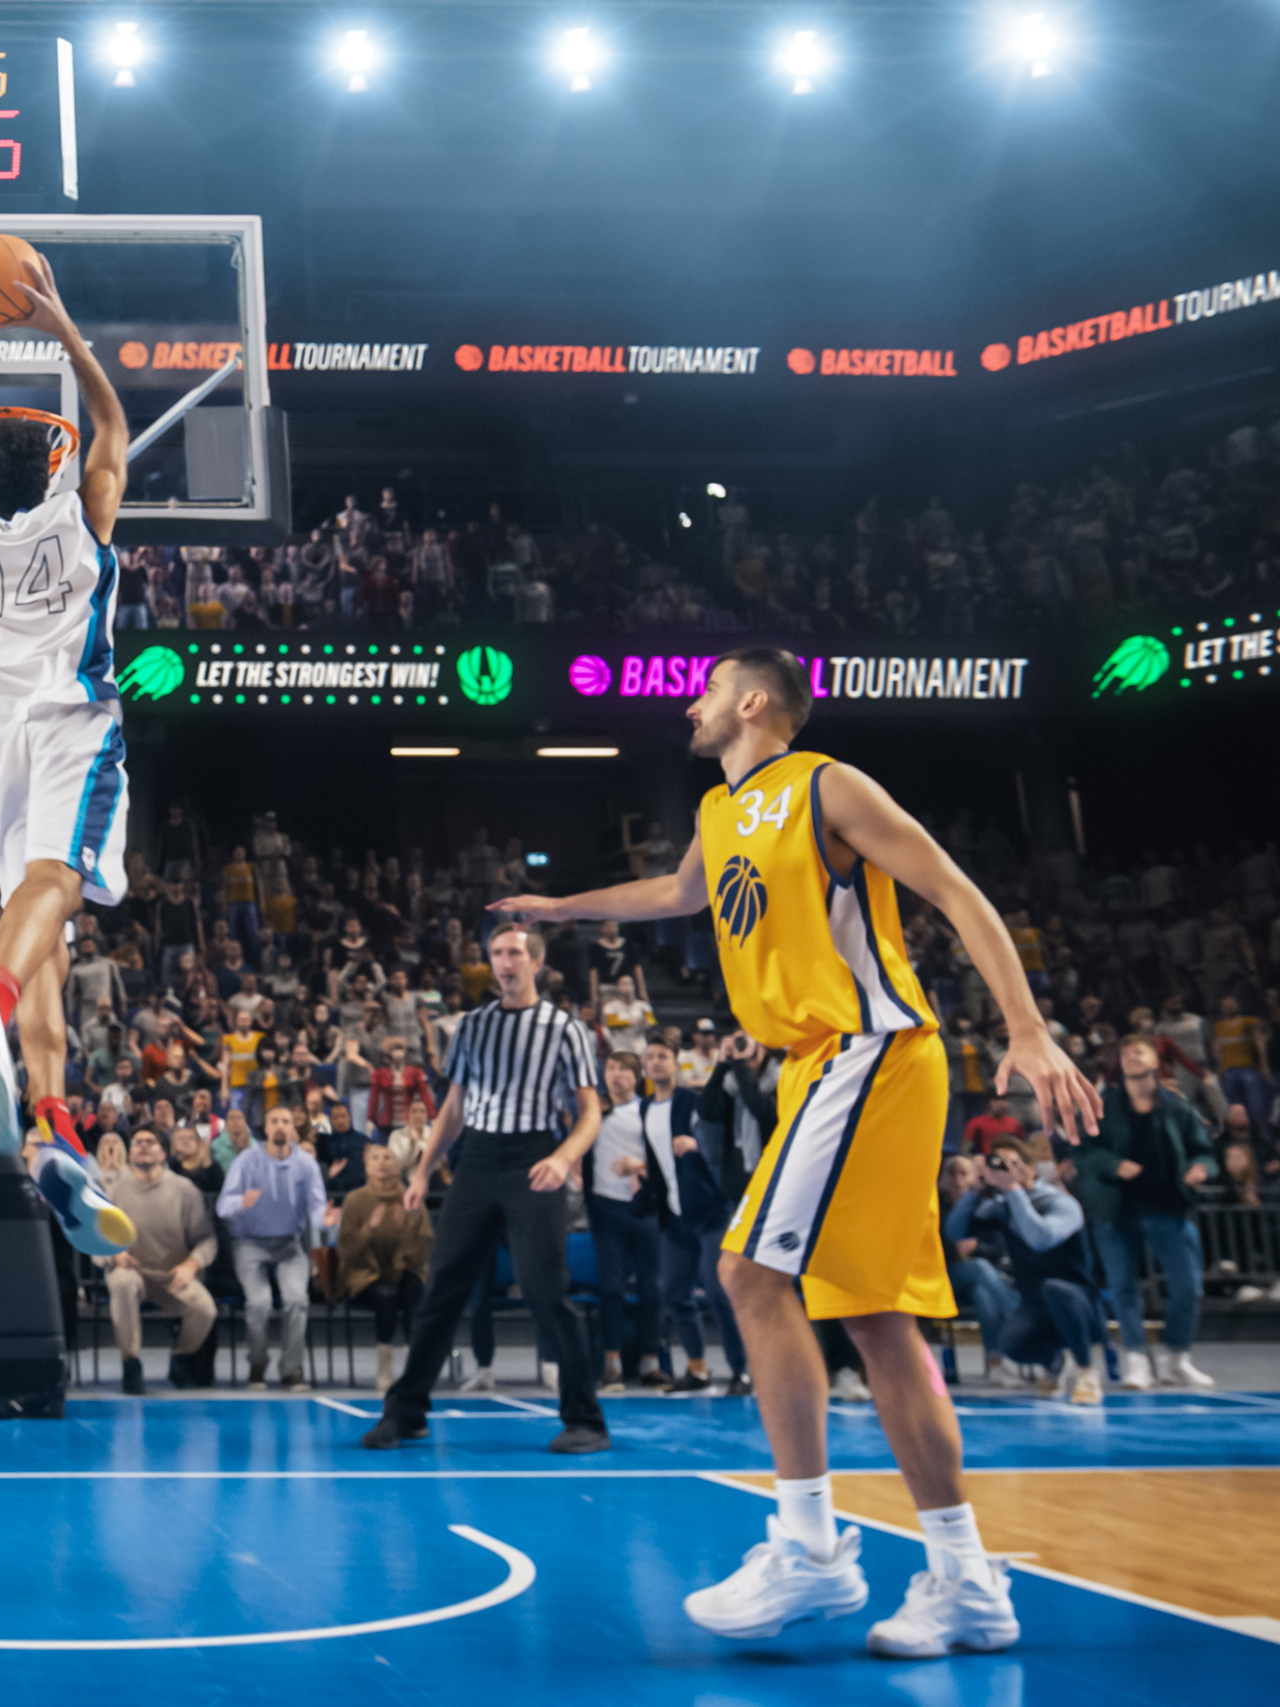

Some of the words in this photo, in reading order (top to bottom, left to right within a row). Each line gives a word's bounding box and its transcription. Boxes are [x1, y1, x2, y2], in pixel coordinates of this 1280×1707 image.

[1016, 299, 1173, 365] BASKETBALL
[151, 341, 293, 370] BASKETLL
[293, 342, 428, 371] TOURNAMENT
[487, 345, 627, 373] BASKETBALL
[627, 345, 760, 374] TOURNAMENT
[819, 348, 958, 376] BASKETBALL
[1184, 636, 1227, 670] LET
[1228, 628, 1274, 662] THE
[195, 660, 234, 687] LET
[235, 660, 273, 687] THE
[273, 661, 390, 688] STRONGEST
[389, 662, 441, 688] WIN!
[829, 656, 1028, 699] TOURNAMENT
[736, 784, 793, 837] 34
